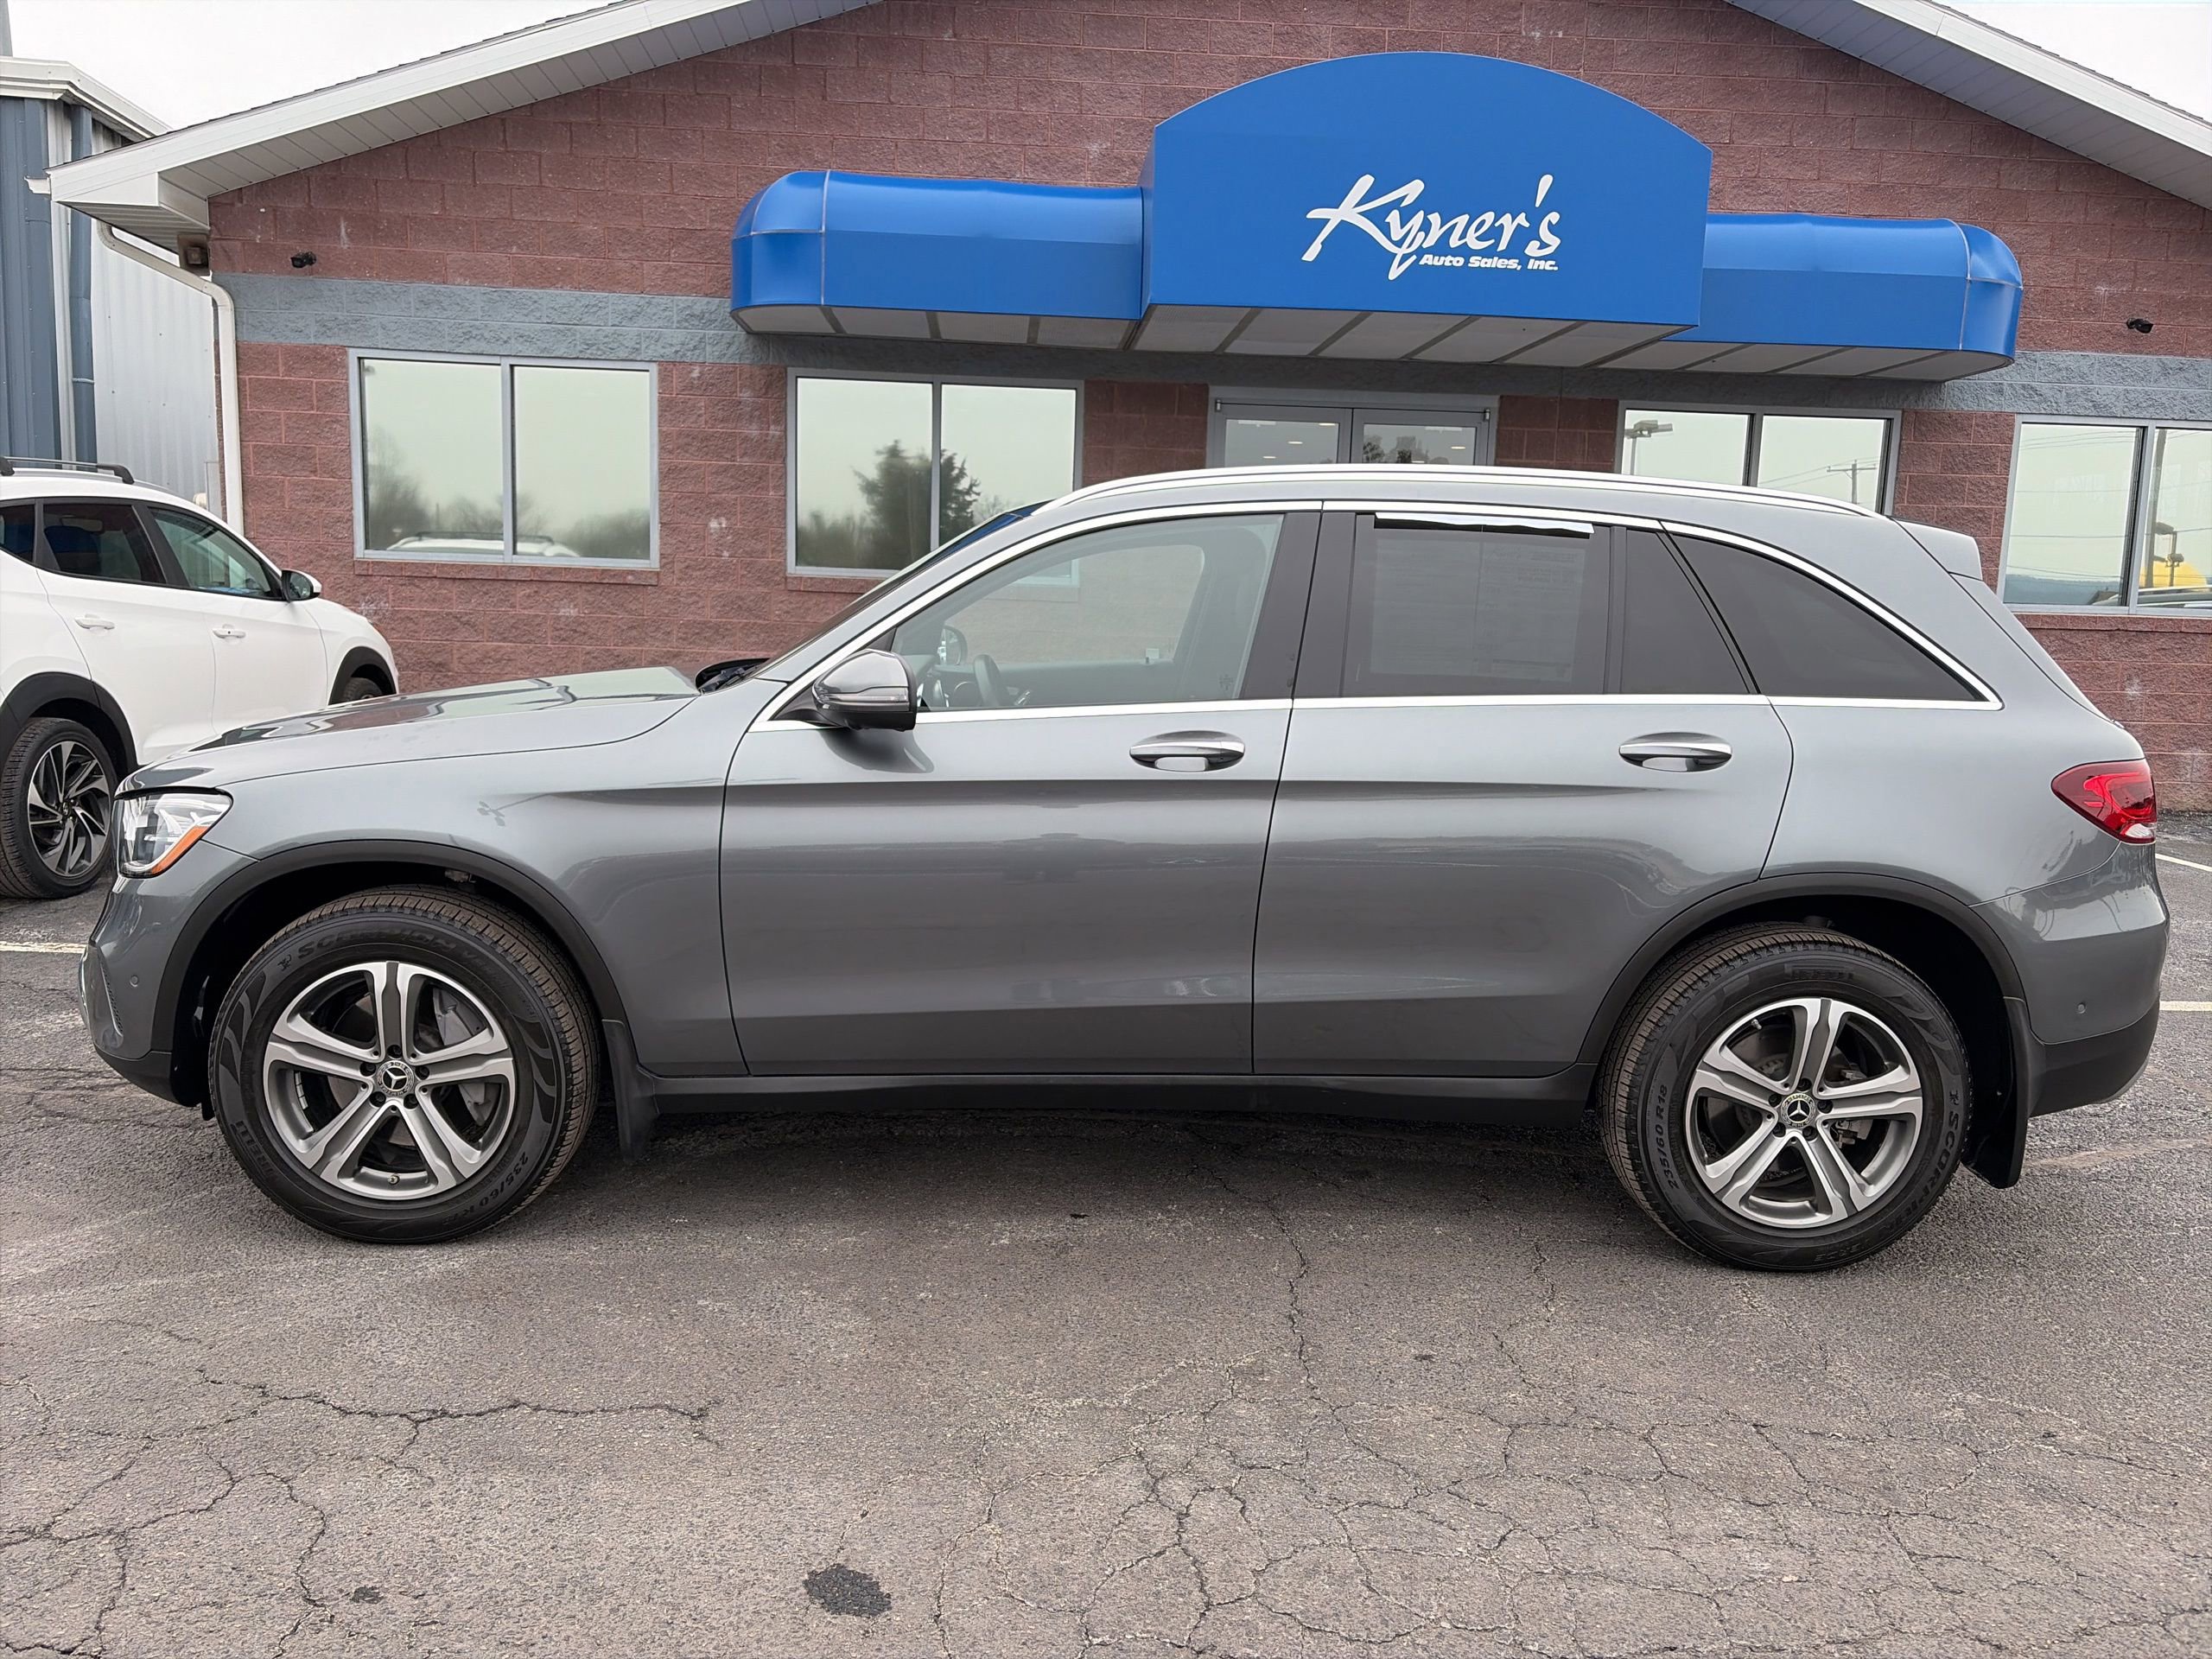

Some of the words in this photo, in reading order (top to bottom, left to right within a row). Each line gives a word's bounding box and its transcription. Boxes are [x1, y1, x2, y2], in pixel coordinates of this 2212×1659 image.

[1301, 174, 1561, 281] Kyner's
[1419, 254, 1465, 268] Auto
[1468, 255, 1522, 270] Sales,
[1527, 258, 1559, 270] Inc.
[1656, 1084, 1668, 1121] R18
[479, 1151, 529, 1207] 235/60
[1655, 1124, 1680, 1190] 235/60
